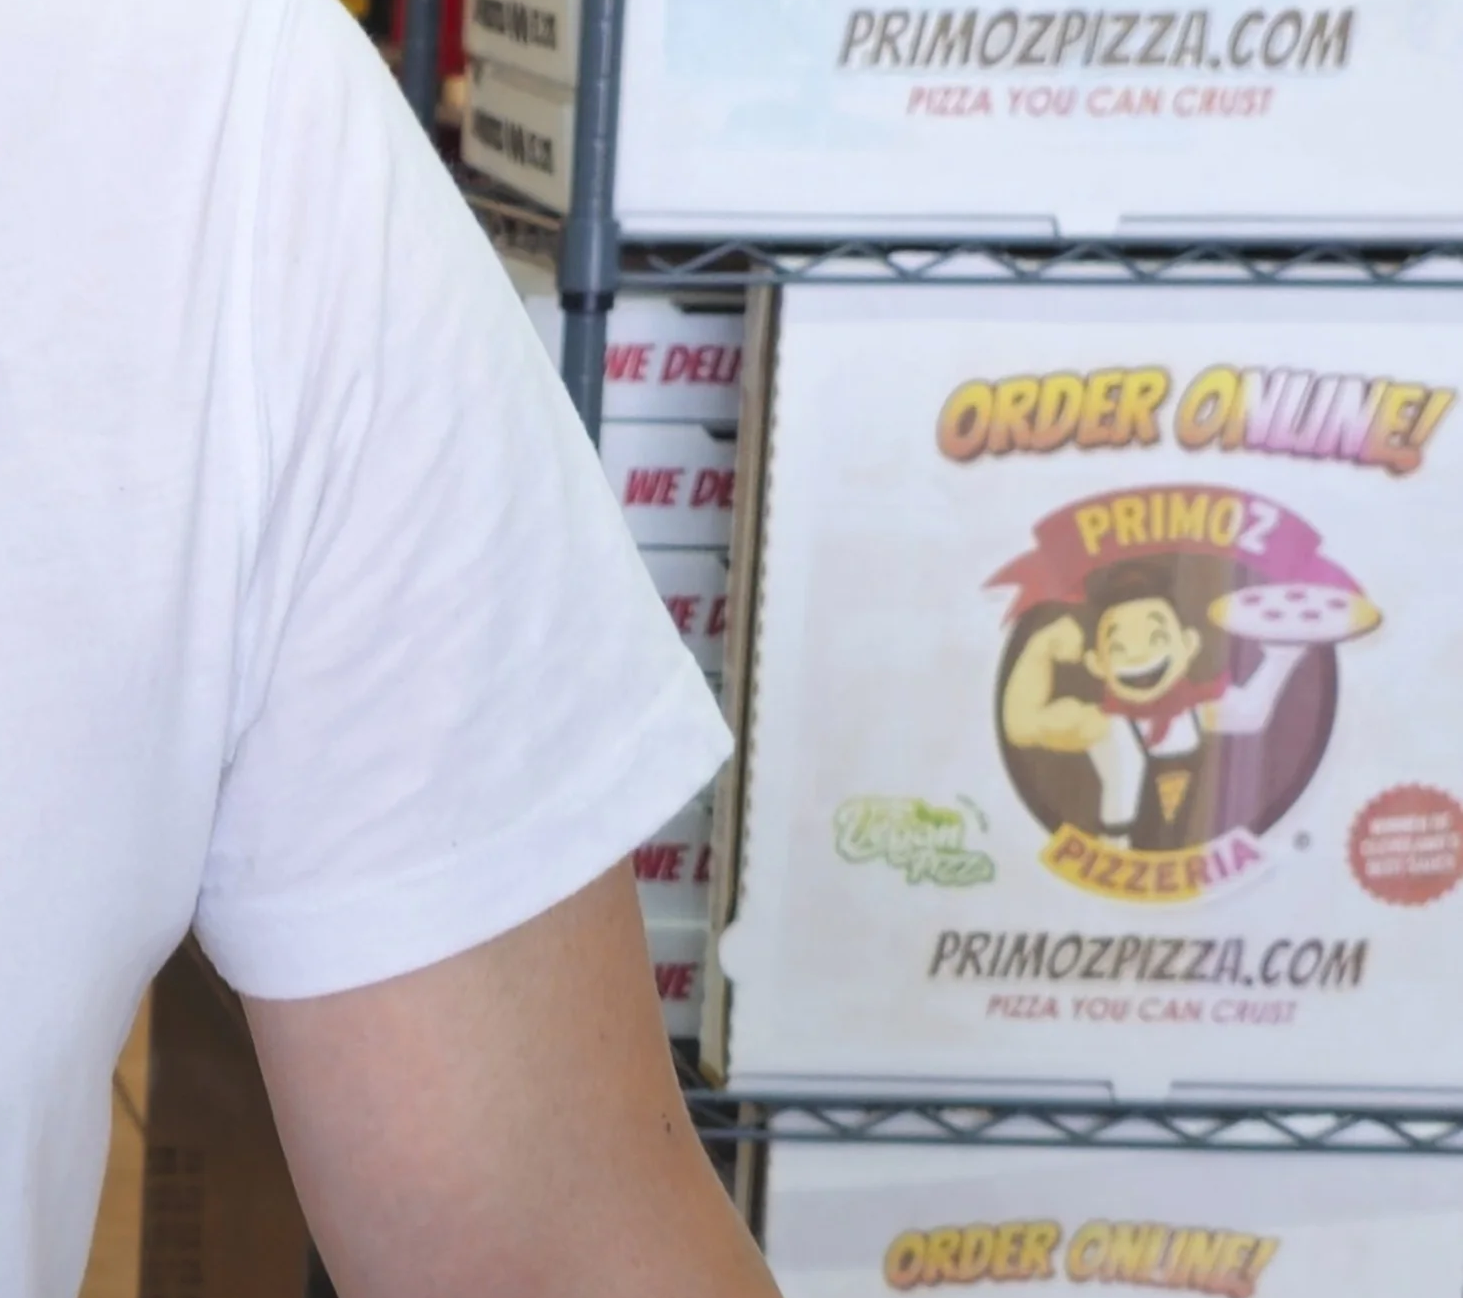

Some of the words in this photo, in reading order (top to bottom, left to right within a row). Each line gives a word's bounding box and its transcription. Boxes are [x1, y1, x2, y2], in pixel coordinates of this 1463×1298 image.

[837, 7, 1357, 71] PRIMOZPIZZA.COM
[906, 84, 994, 118] PIZZA
[1006, 84, 1077, 118] YOU
[1083, 84, 1165, 118] CAN
[1172, 84, 1275, 118] CRUST
[936, 365, 1170, 464] ORDER
[1174, 363, 1457, 478] ONLINE!
[623, 466, 686, 507] WE
[1075, 491, 1283, 556] PRIMOZ
[1052, 833, 1262, 895] PIZZERIA
[927, 929, 1370, 990] PRIMOZPIZZA.COM
[984, 994, 1061, 1021] PIZZA
[1070, 996, 1129, 1023] YOU
[1136, 998, 1202, 1024] CAN
[883, 1219, 1063, 1293] ORDER
